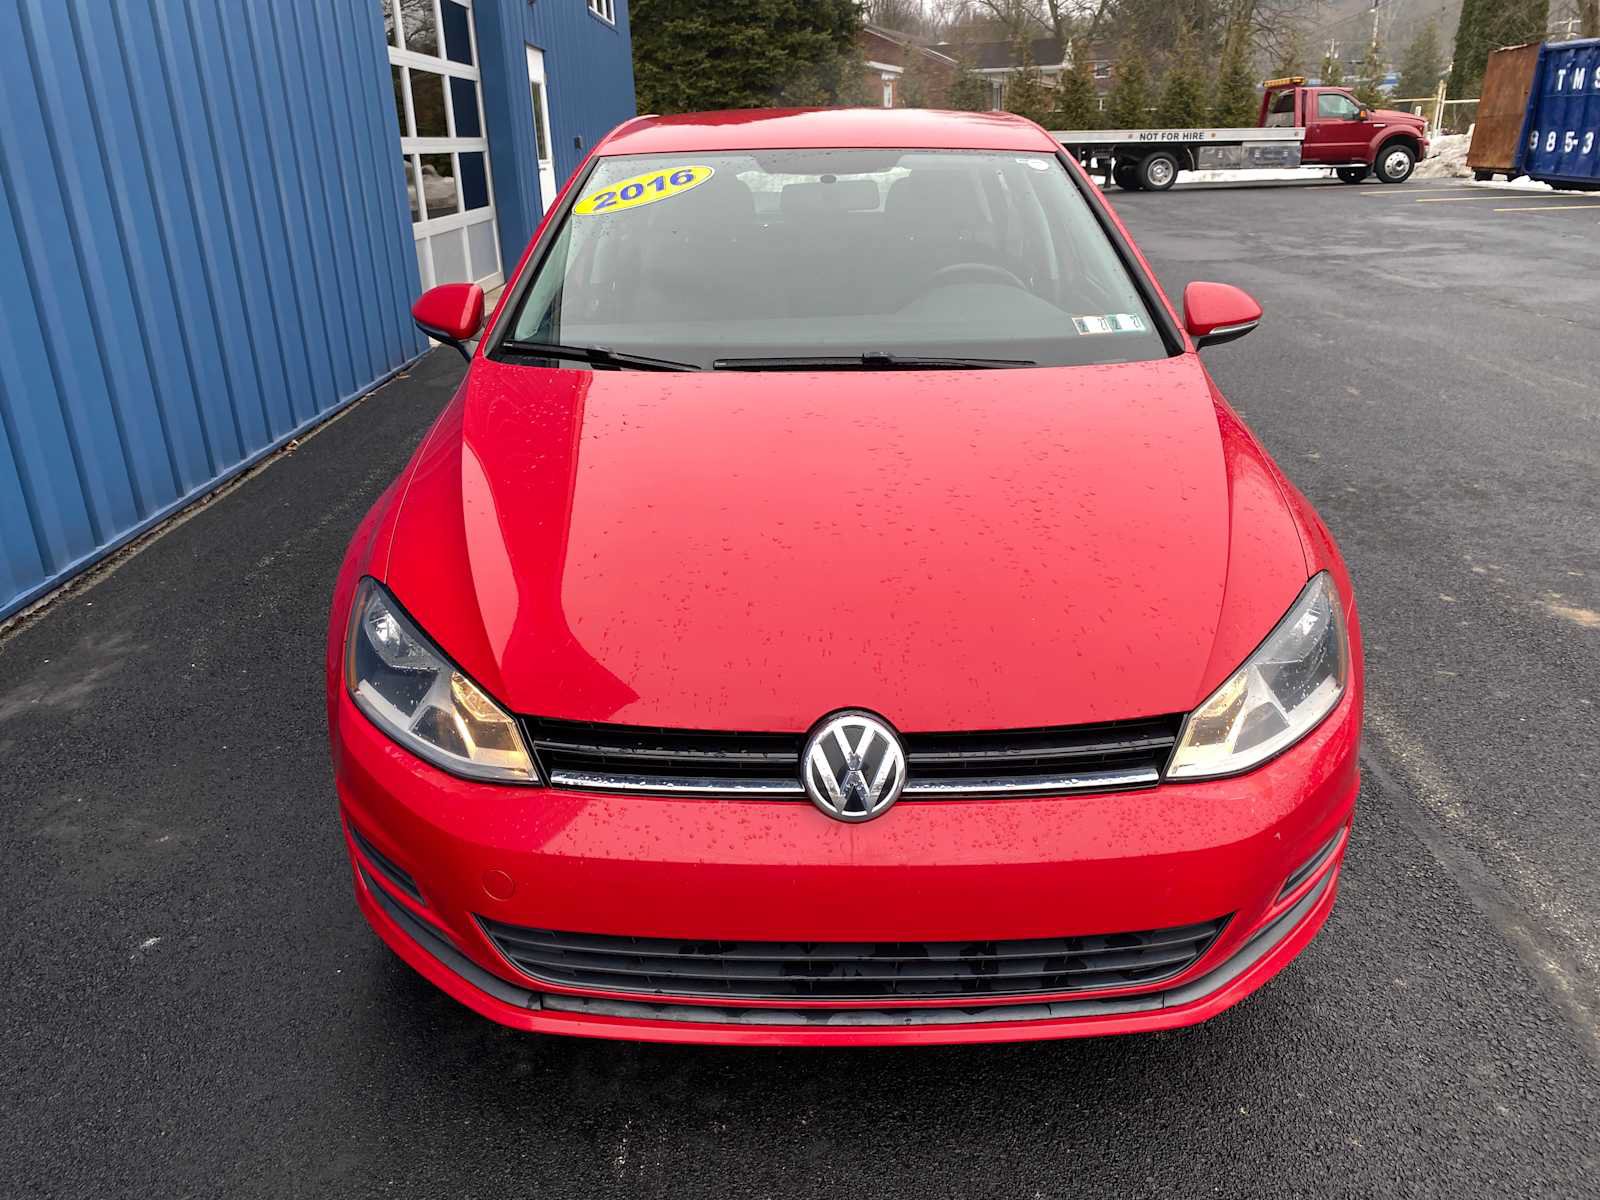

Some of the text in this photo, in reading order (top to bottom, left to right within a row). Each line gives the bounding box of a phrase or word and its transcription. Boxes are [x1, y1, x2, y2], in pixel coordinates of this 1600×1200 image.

[1139, 131, 1205, 141] NOT FOR HIRE
[592, 169, 694, 211] 2016
